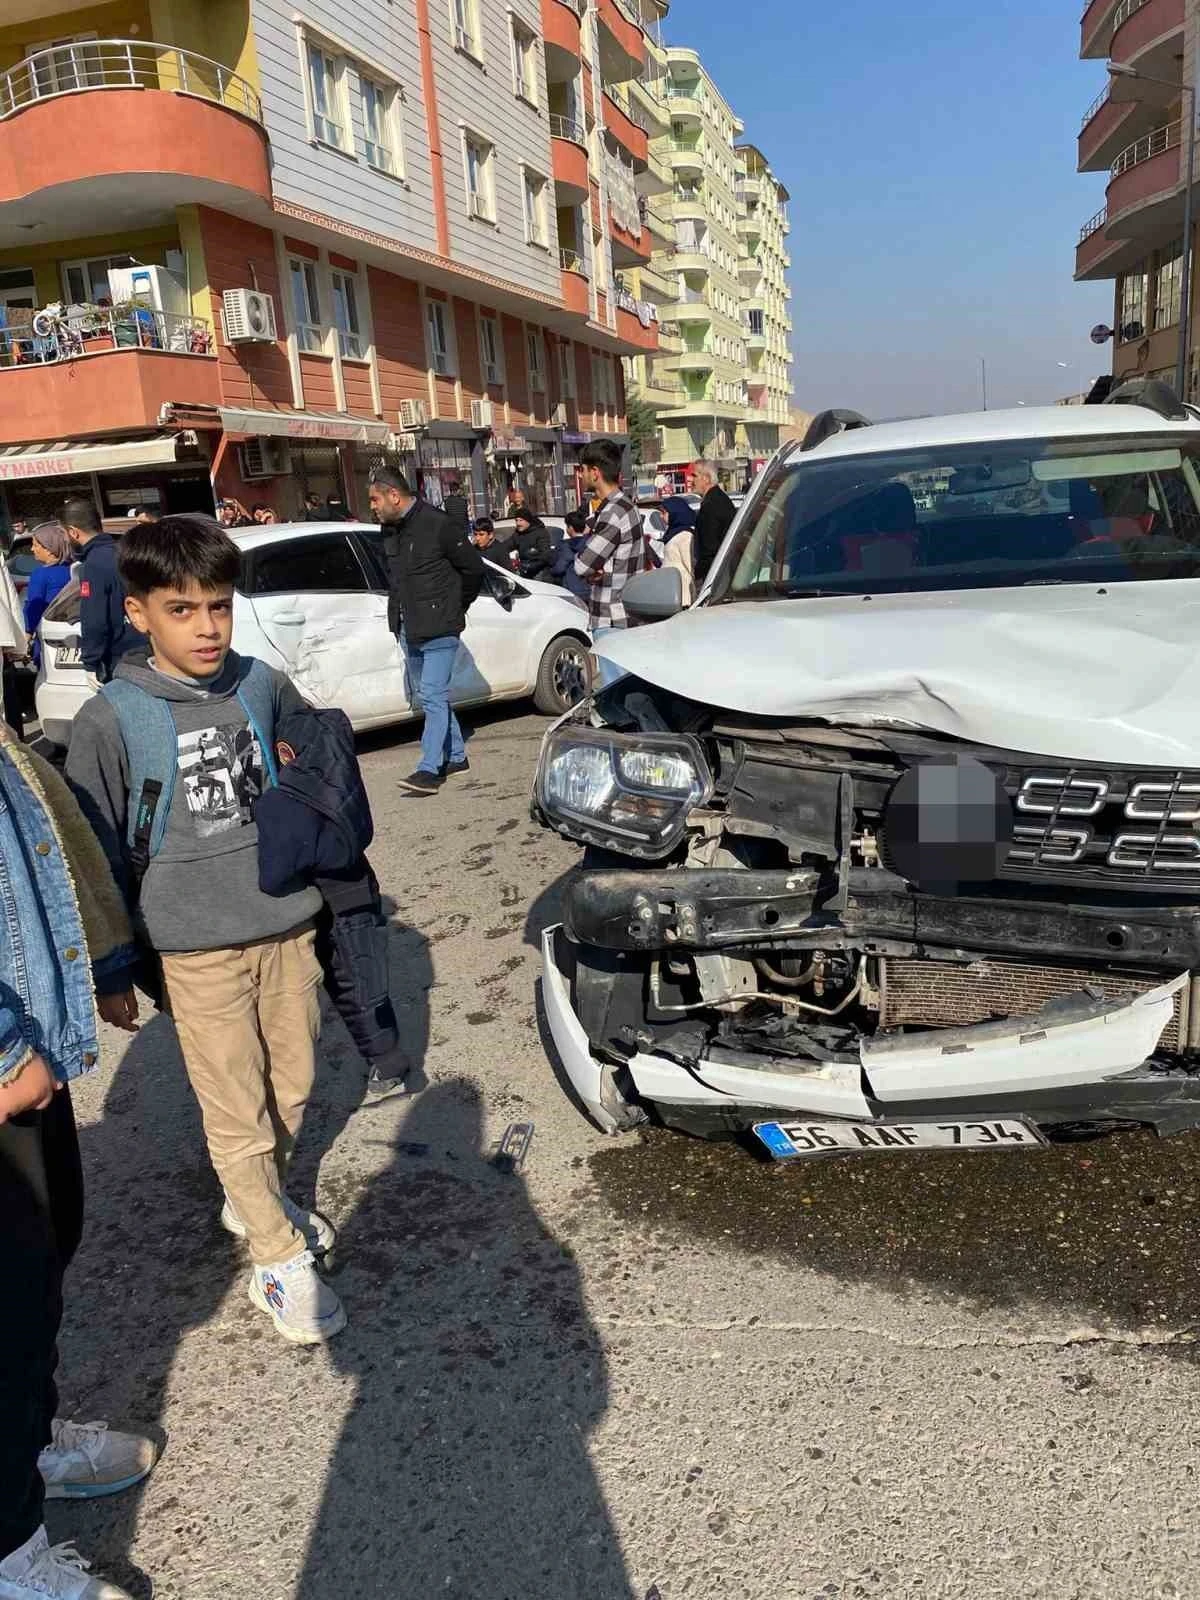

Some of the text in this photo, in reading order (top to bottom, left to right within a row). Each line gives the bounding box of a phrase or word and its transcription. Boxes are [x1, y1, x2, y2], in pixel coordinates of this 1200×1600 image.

[12, 456, 73, 476] MARKET
[783, 1126, 838, 1150] 56
[851, 1126, 918, 1147] AAF
[937, 1123, 1024, 1144] 734
